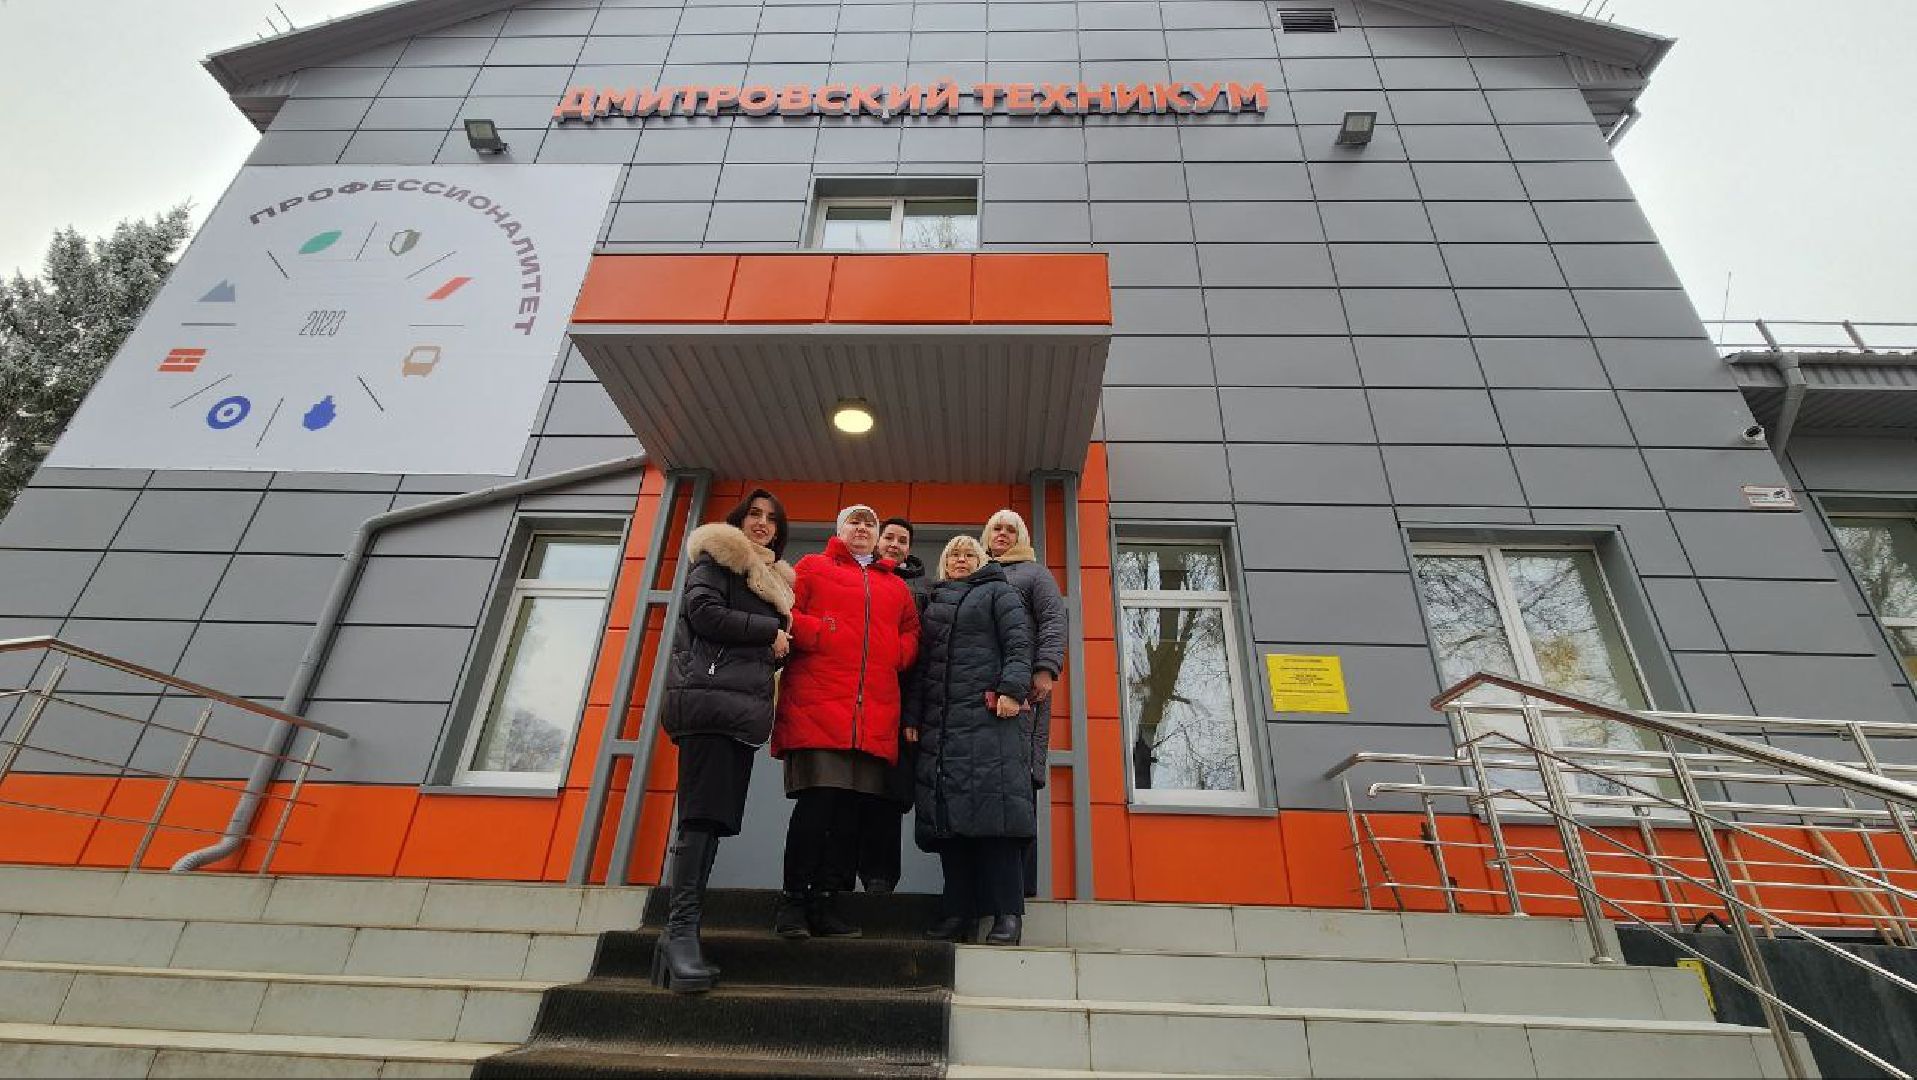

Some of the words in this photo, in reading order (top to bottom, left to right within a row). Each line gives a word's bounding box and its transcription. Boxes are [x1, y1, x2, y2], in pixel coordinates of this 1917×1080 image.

[552, 77, 960, 122] ДМИТРОВСКИЙ
[971, 82, 1270, 116] ТЕХНИКУМ
[249, 178, 543, 336] ПРОФЕССИОНАЛИТЕТ
[298, 309, 347, 336] 2023
